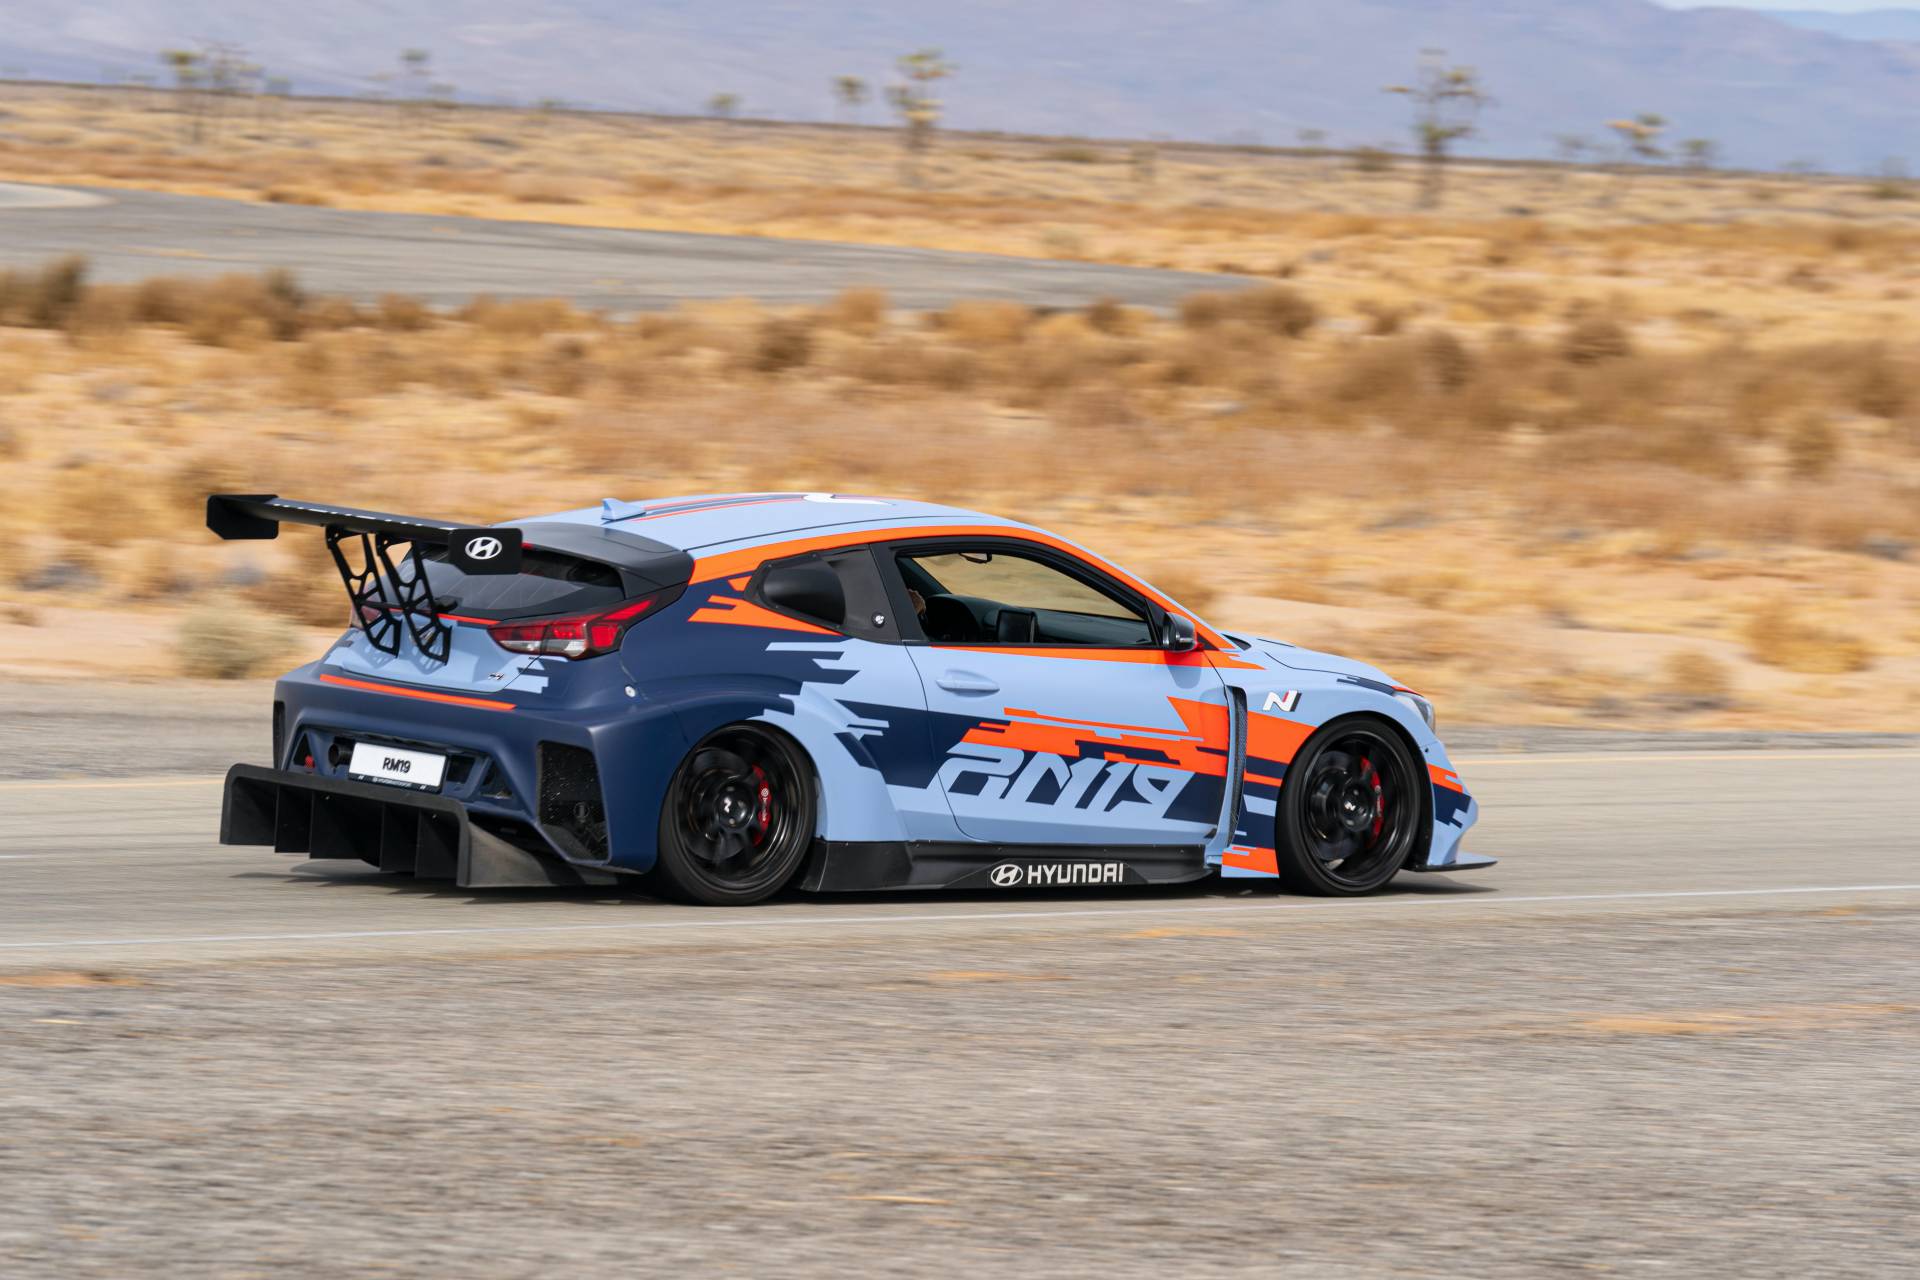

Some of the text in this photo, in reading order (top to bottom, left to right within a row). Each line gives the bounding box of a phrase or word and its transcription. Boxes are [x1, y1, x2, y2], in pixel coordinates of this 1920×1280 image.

[1262, 689, 1302, 712] N
[382, 757, 411, 774] RM19
[925, 740, 1197, 820] RM19
[1027, 863, 1124, 884] HYUNDAI
